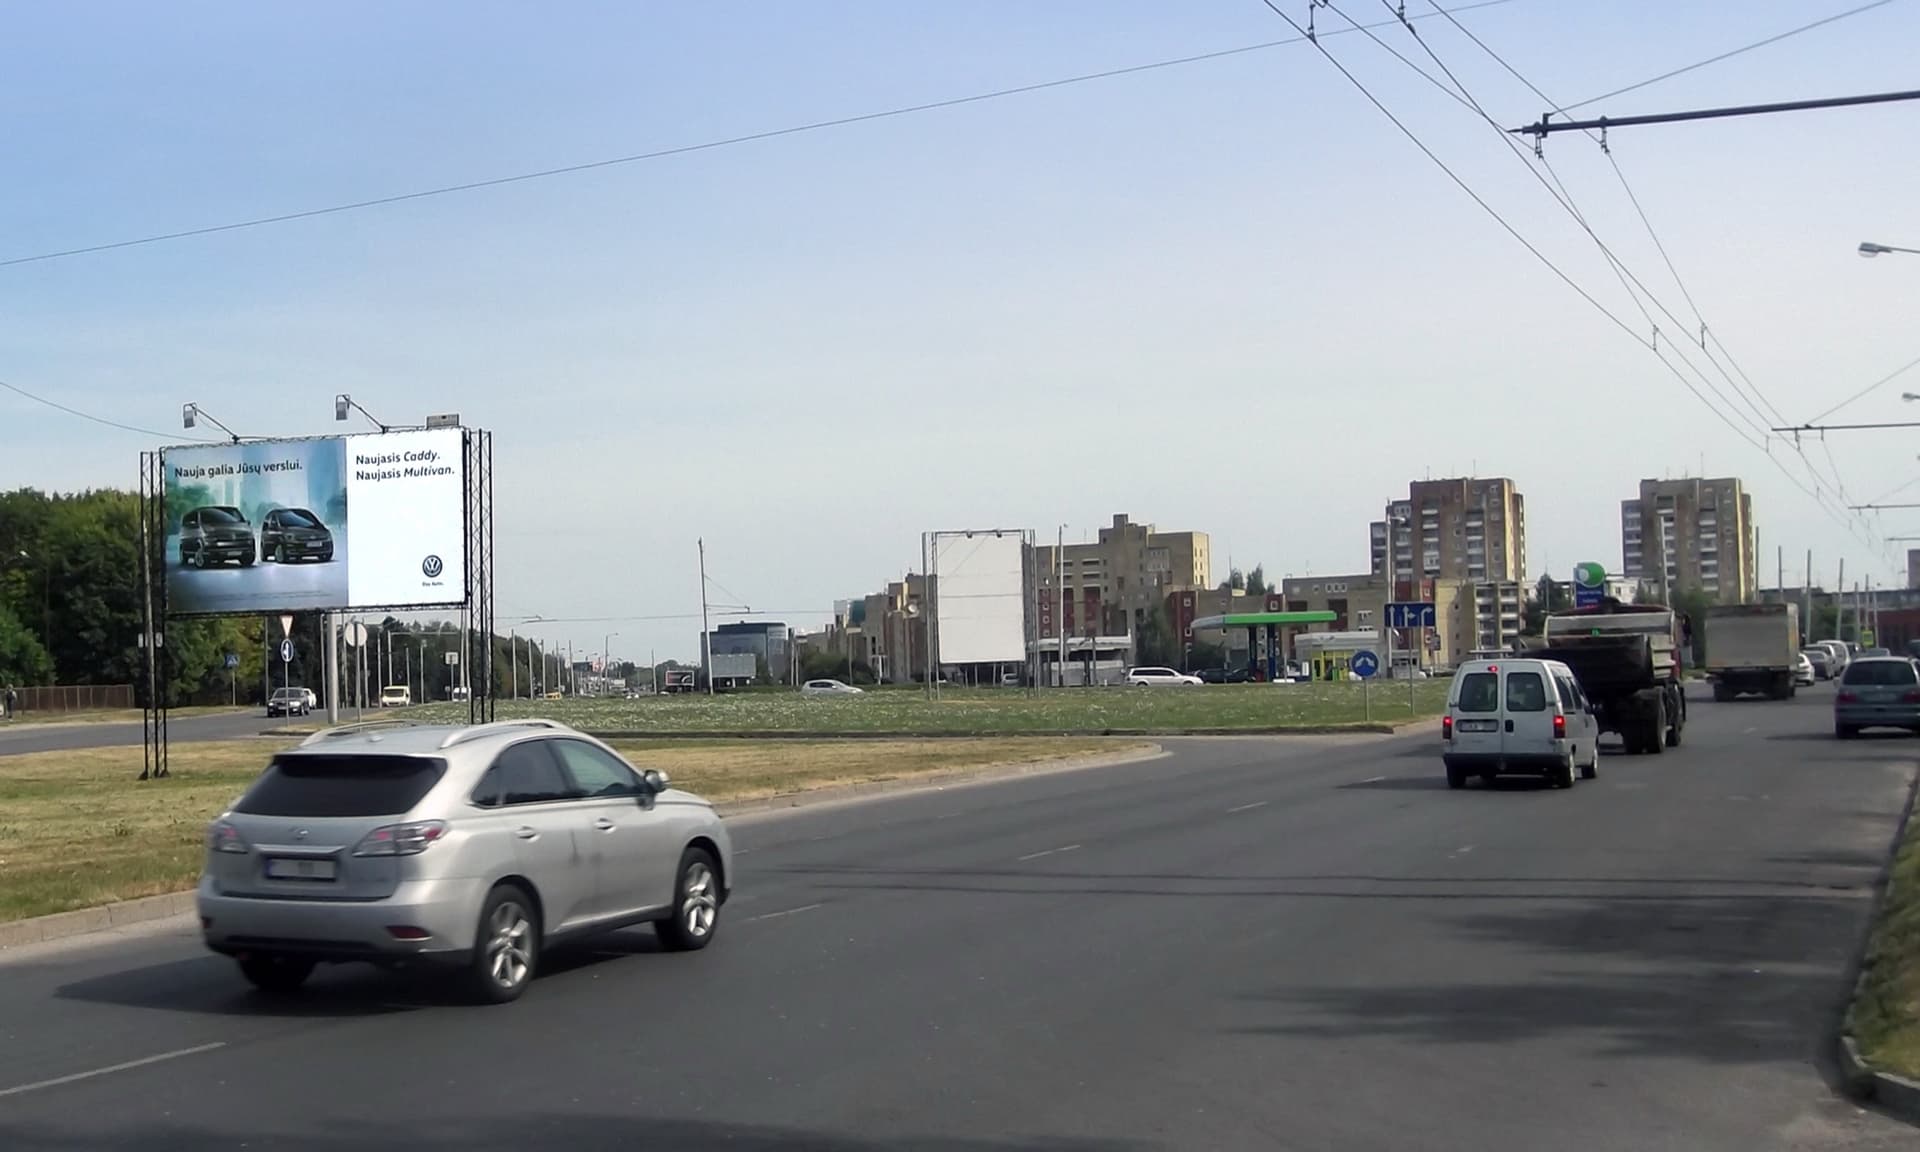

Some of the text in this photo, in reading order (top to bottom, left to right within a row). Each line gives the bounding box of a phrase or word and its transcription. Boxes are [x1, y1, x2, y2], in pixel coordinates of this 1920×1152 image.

[356, 449, 441, 466] Naujasis Caddy.
[174, 465, 206, 479] Nauja
[207, 463, 234, 479] galia
[263, 459, 303, 472] verslui.
[356, 465, 455, 482] Naujasis Multivan.
